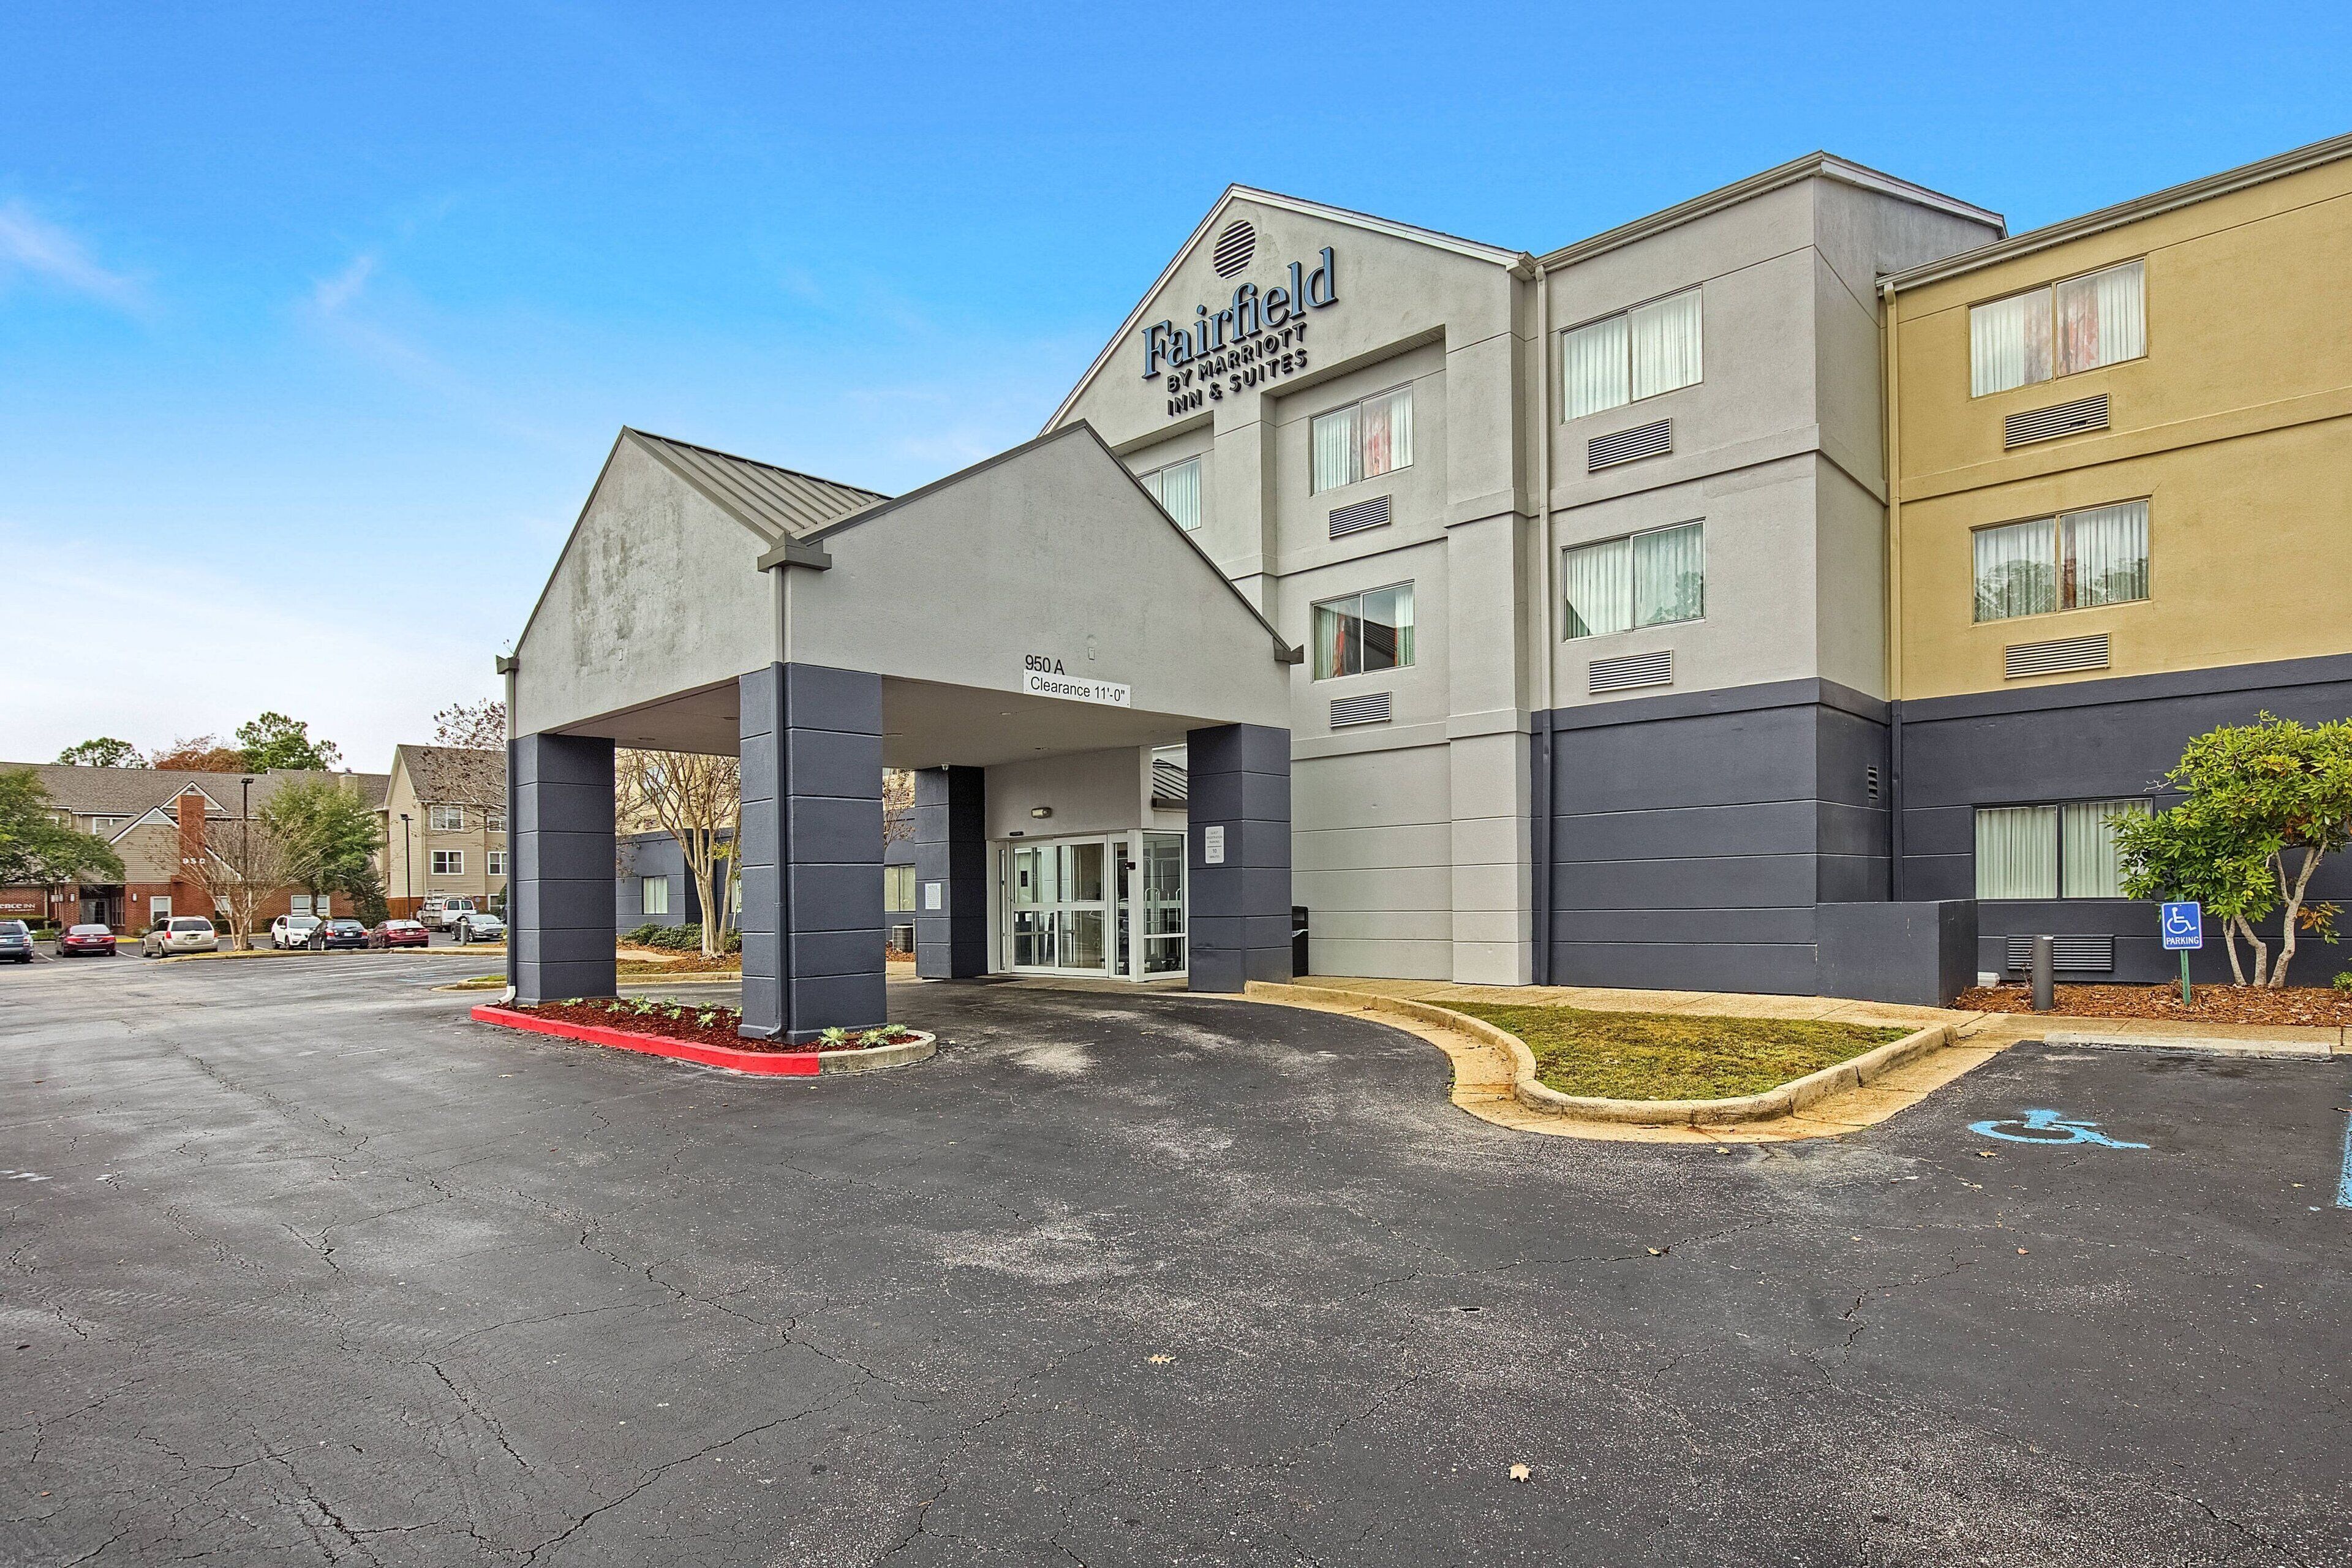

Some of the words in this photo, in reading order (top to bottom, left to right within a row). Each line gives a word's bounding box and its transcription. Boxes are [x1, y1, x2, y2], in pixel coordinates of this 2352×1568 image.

[1141, 246, 1339, 379] Fairfield
[1167, 368, 1193, 393] BY
[1197, 322, 1307, 382] MARRIOTT
[1167, 388, 1202, 416] INN
[1209, 382, 1223, 400] &
[1229, 348, 1307, 393] SUITES
[1025, 654, 1051, 673] 950
[1054, 658, 1065, 676] A
[1030, 676, 1090, 697] Clearance
[1095, 685, 1125, 702] 11'-0"
[2166, 936, 2199, 945] PARKING
